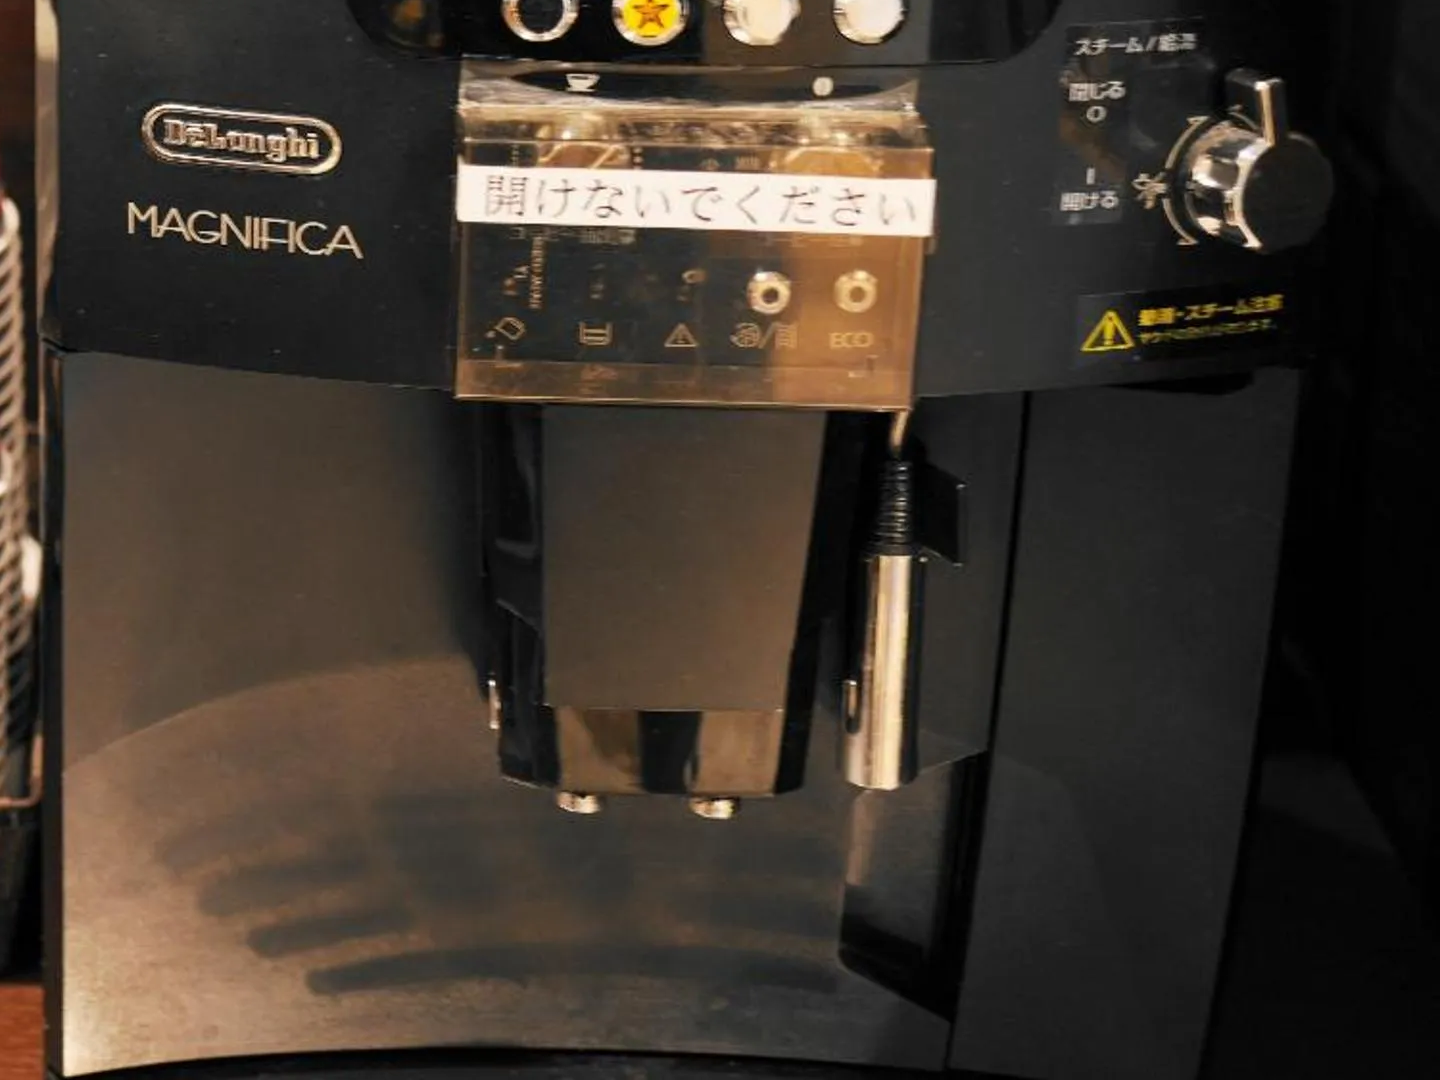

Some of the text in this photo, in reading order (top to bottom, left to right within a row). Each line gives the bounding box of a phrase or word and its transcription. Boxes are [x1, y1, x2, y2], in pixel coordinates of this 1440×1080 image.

[484, 173, 918, 228] 開けないでください
[126, 201, 365, 260] MAGNIFICA
